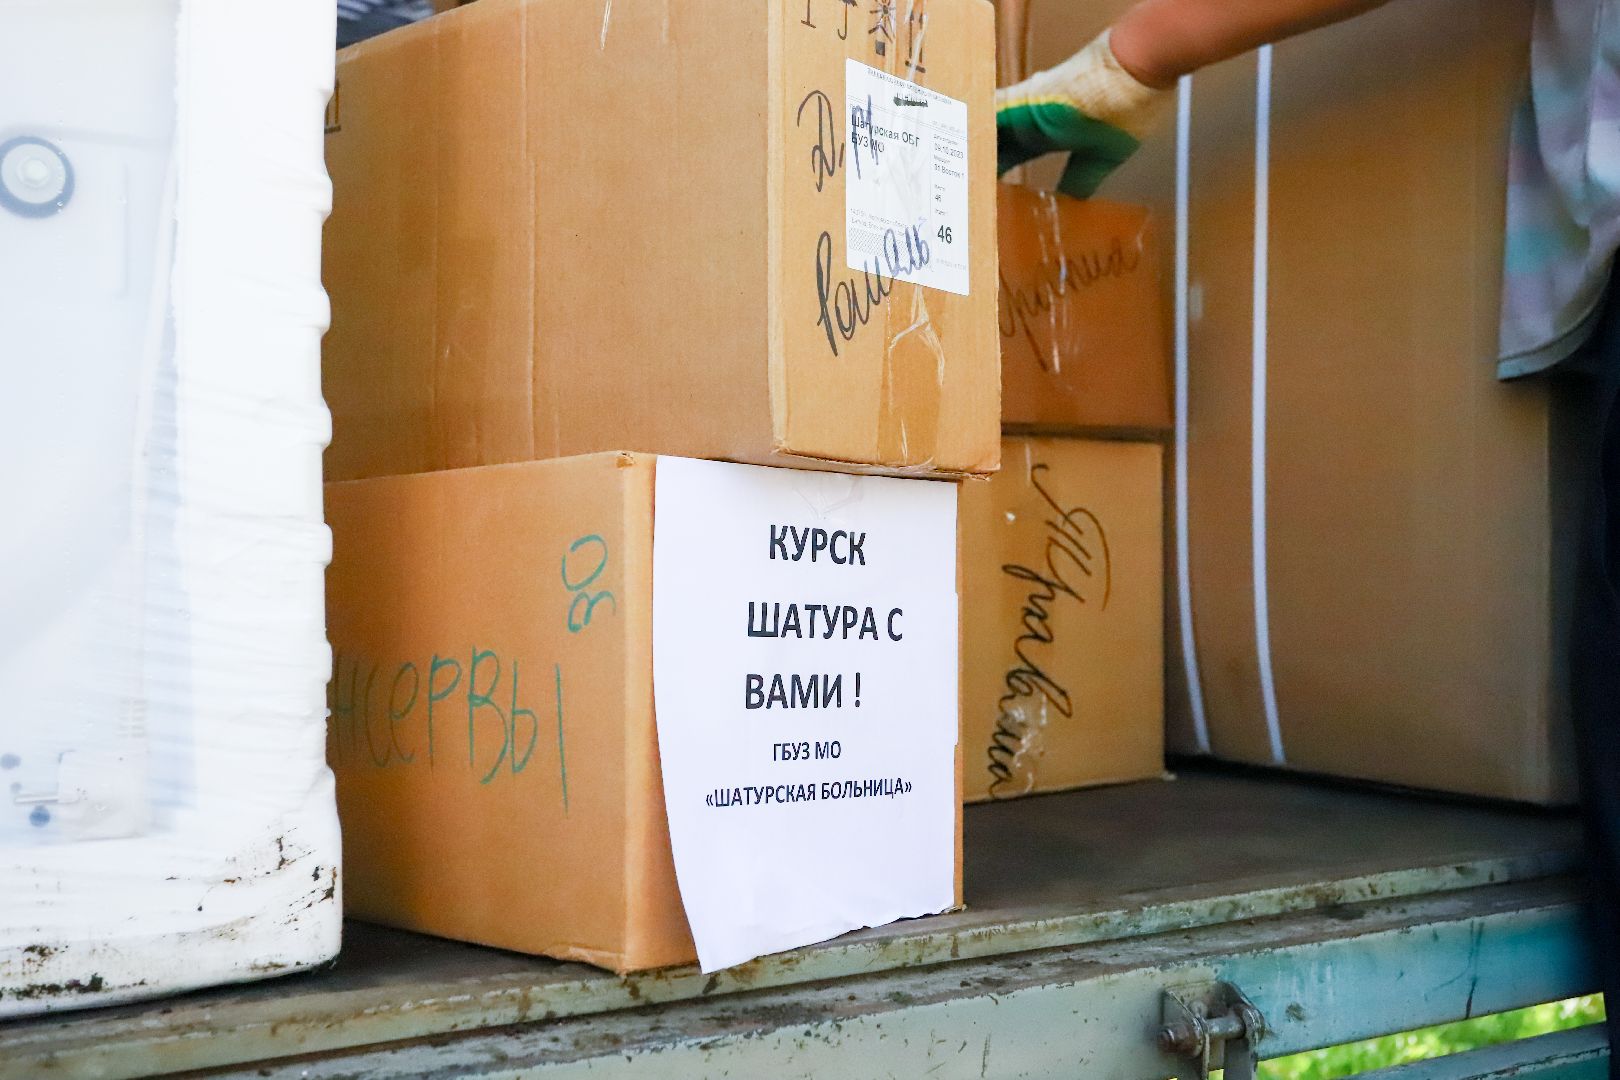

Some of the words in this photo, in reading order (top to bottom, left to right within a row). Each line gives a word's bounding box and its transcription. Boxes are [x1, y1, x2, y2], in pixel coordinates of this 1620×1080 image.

[937, 224, 952, 244] 46
[769, 524, 867, 565] КУРСК
[747, 601, 879, 641] ШАТУРА
[887, 607, 903, 641] С
[745, 673, 842, 710] ВАМИ
[773, 742, 810, 762] ГБУЗ
[815, 740, 841, 760] МО
[705, 783, 816, 808] «ШАТУРСКАЯ
[821, 777, 912, 800] БОЛЬНИЦА»
